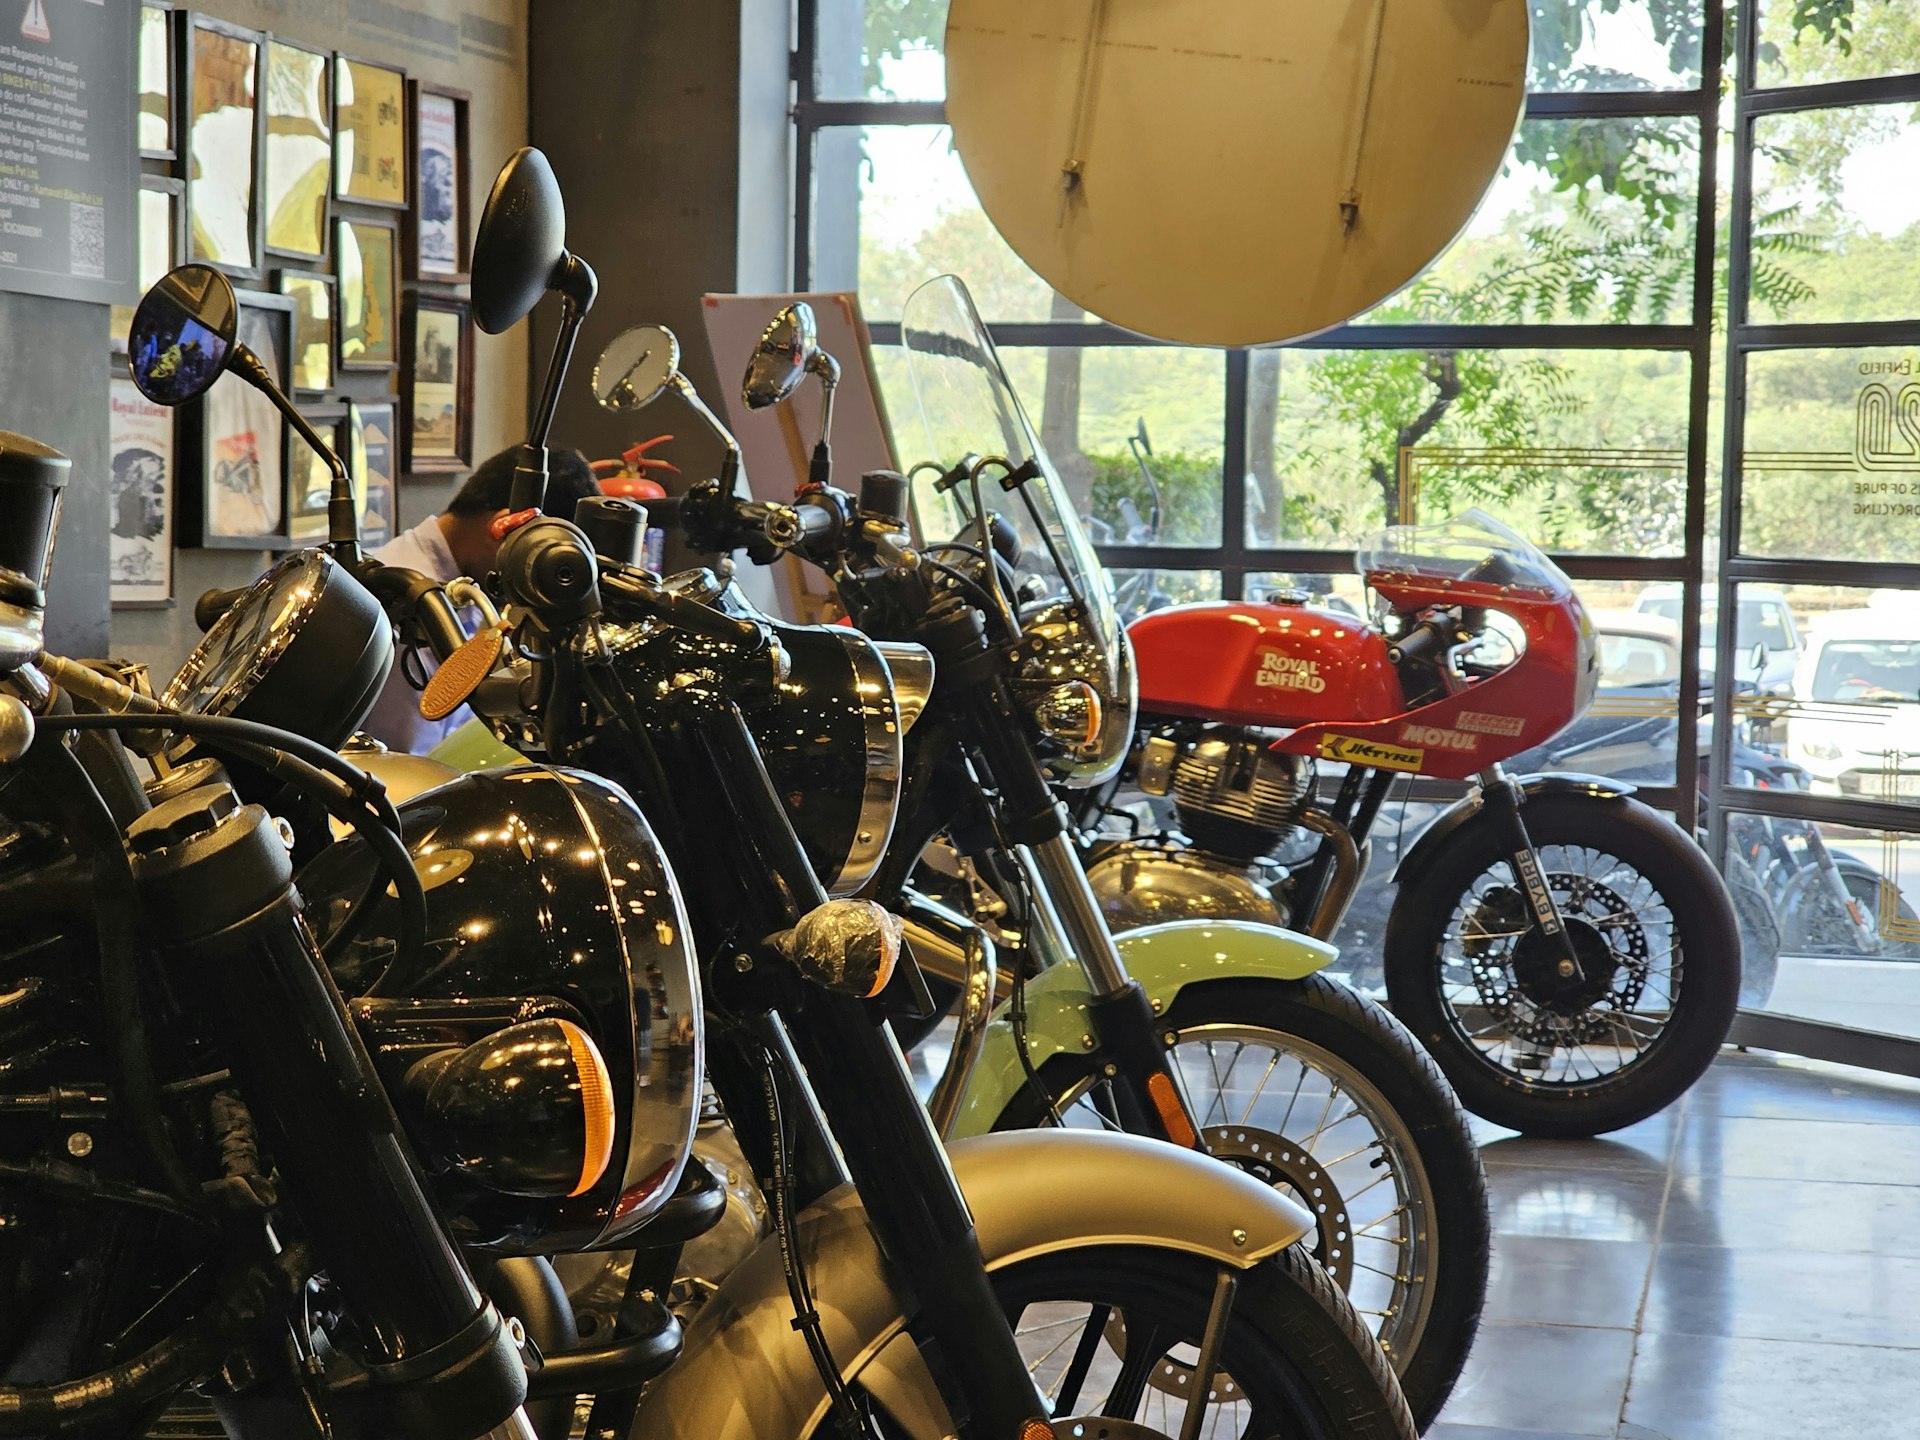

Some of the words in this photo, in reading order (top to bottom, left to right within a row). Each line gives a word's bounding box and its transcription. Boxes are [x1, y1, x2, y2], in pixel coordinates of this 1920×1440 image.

[12, 45, 46, 65] Requested
[46, 55, 53, 66] to
[53, 56, 78, 72] Transfer
[3, 73, 24, 88] BIKES
[52, 86, 77, 102] Account
[25, 66, 37, 79] any
[38, 67, 65, 85] Payment
[3, 89, 13, 100] do
[14, 93, 25, 104] not
[26, 93, 52, 109] Transfer
[64, 103, 88, 118] Amount
[3, 103, 35, 121] Executive
[36, 113, 61, 127] account
[69, 120, 85, 132] other
[12, 135, 22, 146] for
[22, 138, 34, 152] any
[35, 139, 74, 158] Transactions
[48, 128, 64, 142] Bikes
[4, 149, 22, 161] other
[3, 177, 21, 190] ONLY
[1263, 652, 1319, 675] ROYAL
[1255, 669, 1326, 694] ENFIELD
[1402, 724, 1477, 751] MOTUL
[1518, 850, 1551, 916] BYBRE
